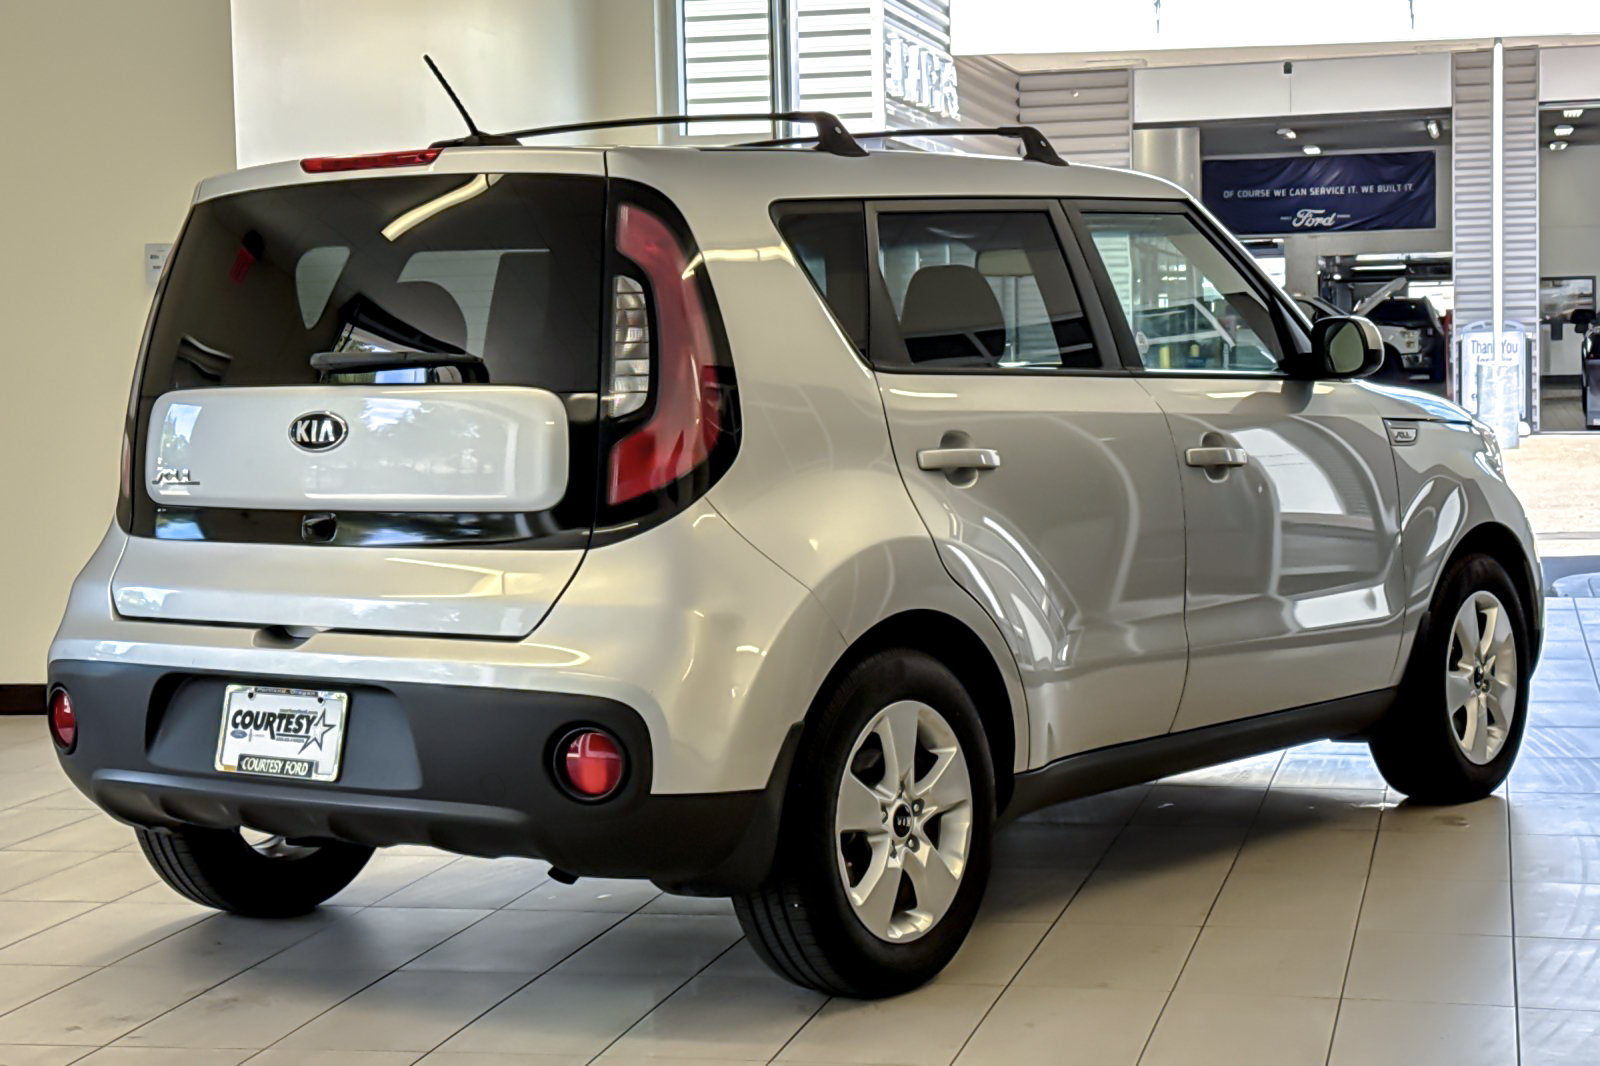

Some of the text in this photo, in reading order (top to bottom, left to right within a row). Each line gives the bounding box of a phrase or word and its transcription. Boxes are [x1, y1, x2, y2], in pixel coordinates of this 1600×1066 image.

[1223, 190, 1234, 198] OF
[1237, 189, 1270, 198] COURSE
[1273, 188, 1287, 197] WE
[1289, 188, 1307, 196] CAN
[1309, 186, 1345, 196] SERVICE
[1361, 185, 1375, 194] WE
[1377, 184, 1402, 193] BUILT
[1292, 208, 1336, 227] Ford
[1501, 339, 1518, 354] You
[296, 419, 335, 442] KIA
[231, 709, 317, 740] COURTESY
[242, 757, 309, 776] COURTESY FORD
